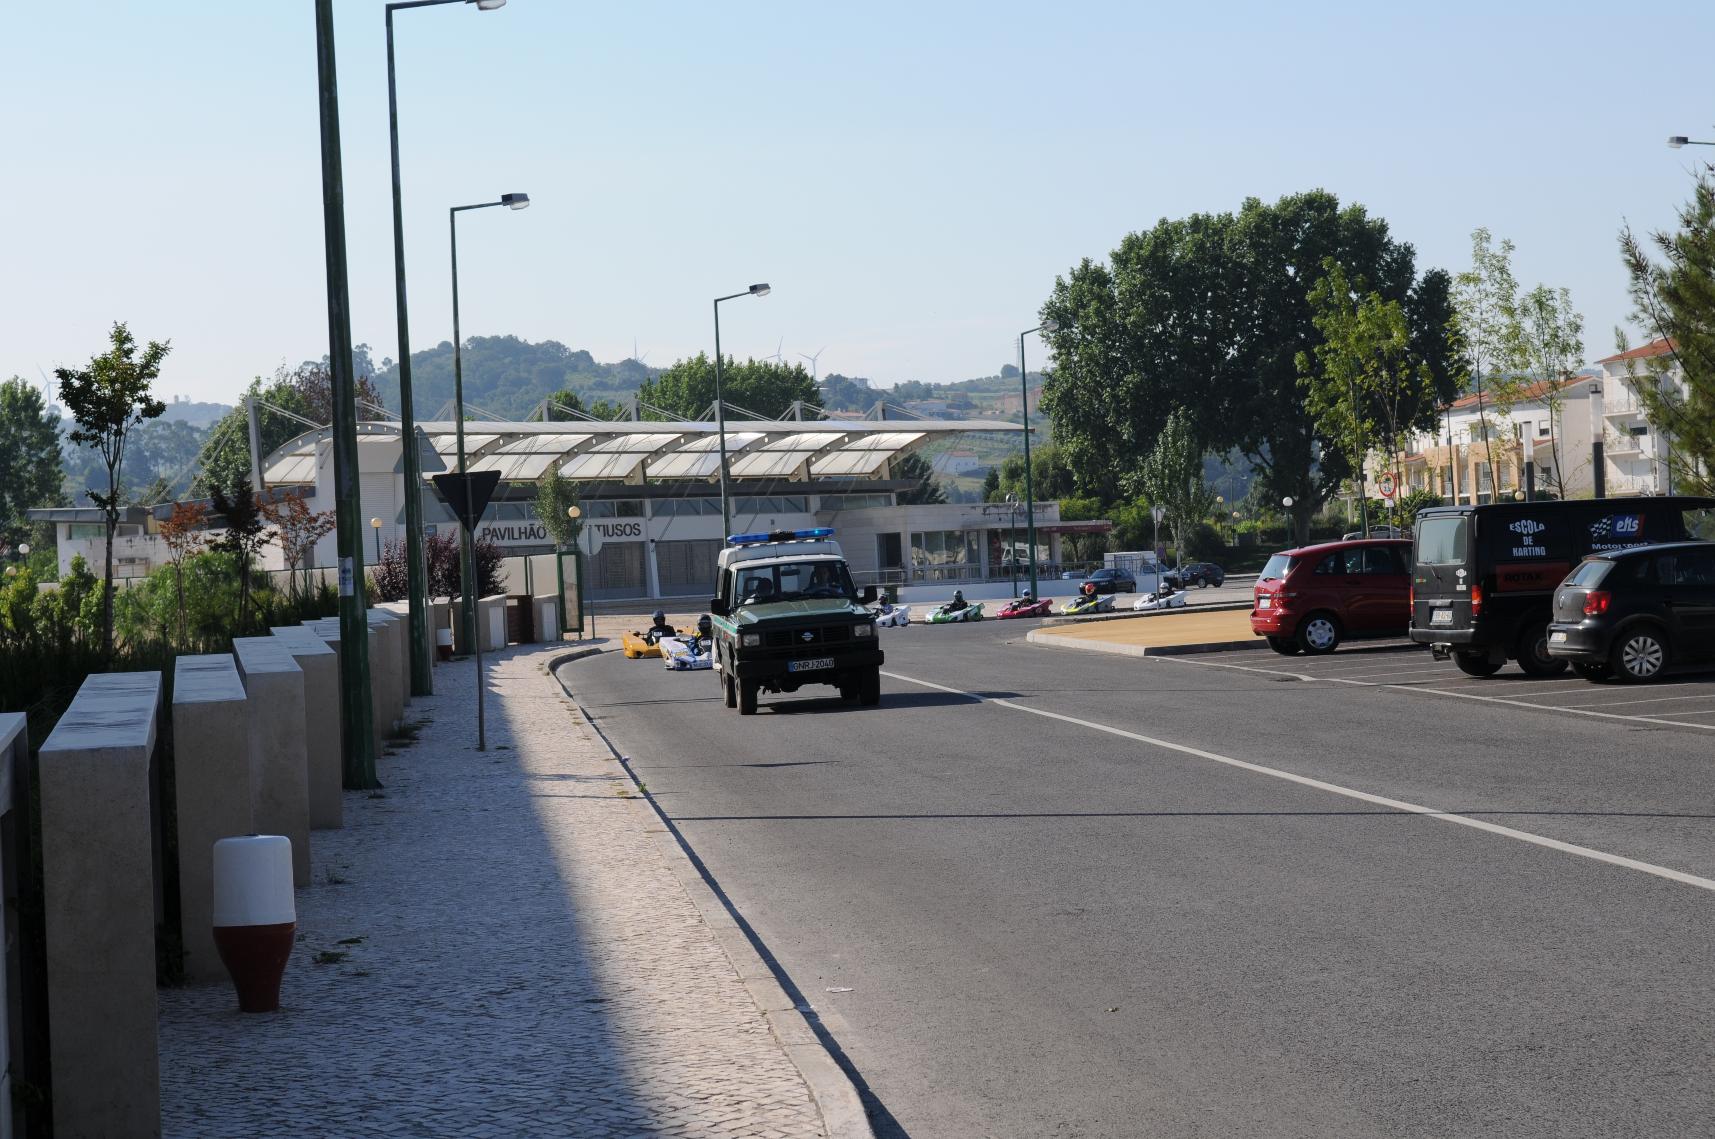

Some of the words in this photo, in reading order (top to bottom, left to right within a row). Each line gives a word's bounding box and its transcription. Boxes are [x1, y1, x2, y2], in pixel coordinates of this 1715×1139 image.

[482, 523, 547, 541] PAVILHÃO
[1509, 519, 1545, 534] ESCOLA
[1522, 535, 1535, 546] DE
